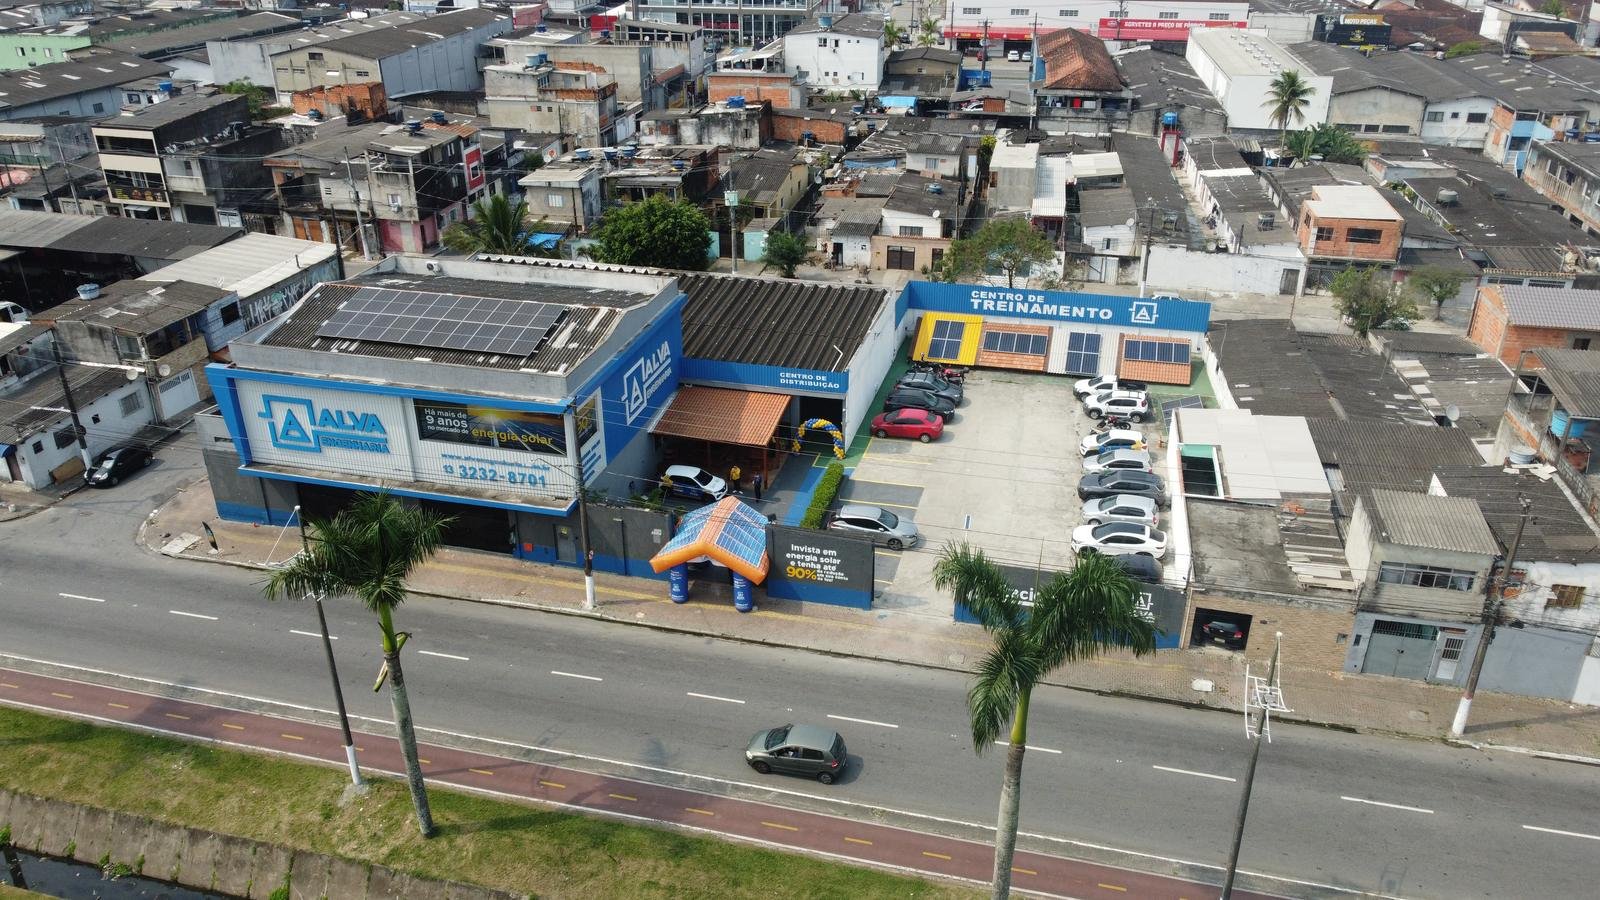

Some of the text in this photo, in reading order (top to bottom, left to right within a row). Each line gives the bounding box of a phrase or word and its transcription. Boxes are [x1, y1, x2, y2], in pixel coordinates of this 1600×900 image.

[970, 290, 1045, 303] CENTRO DE
[970, 298, 1113, 320] TREINAMENTO
[645, 340, 671, 378] ALVA
[779, 372, 813, 380] CENTRO
[780, 379, 840, 389] DISTRIBUIÇÃO
[424, 408, 467, 419] Há mais de
[319, 408, 387, 434] ALVA
[425, 416, 468, 428] 9 anos
[472, 428, 553, 445] energia solar
[458, 464, 546, 488] 3232-8701
[791, 544, 837, 557] Invista em
[786, 552, 841, 565] energia solar
[797, 561, 821, 569] tenha
[786, 566, 817, 581] 90%
